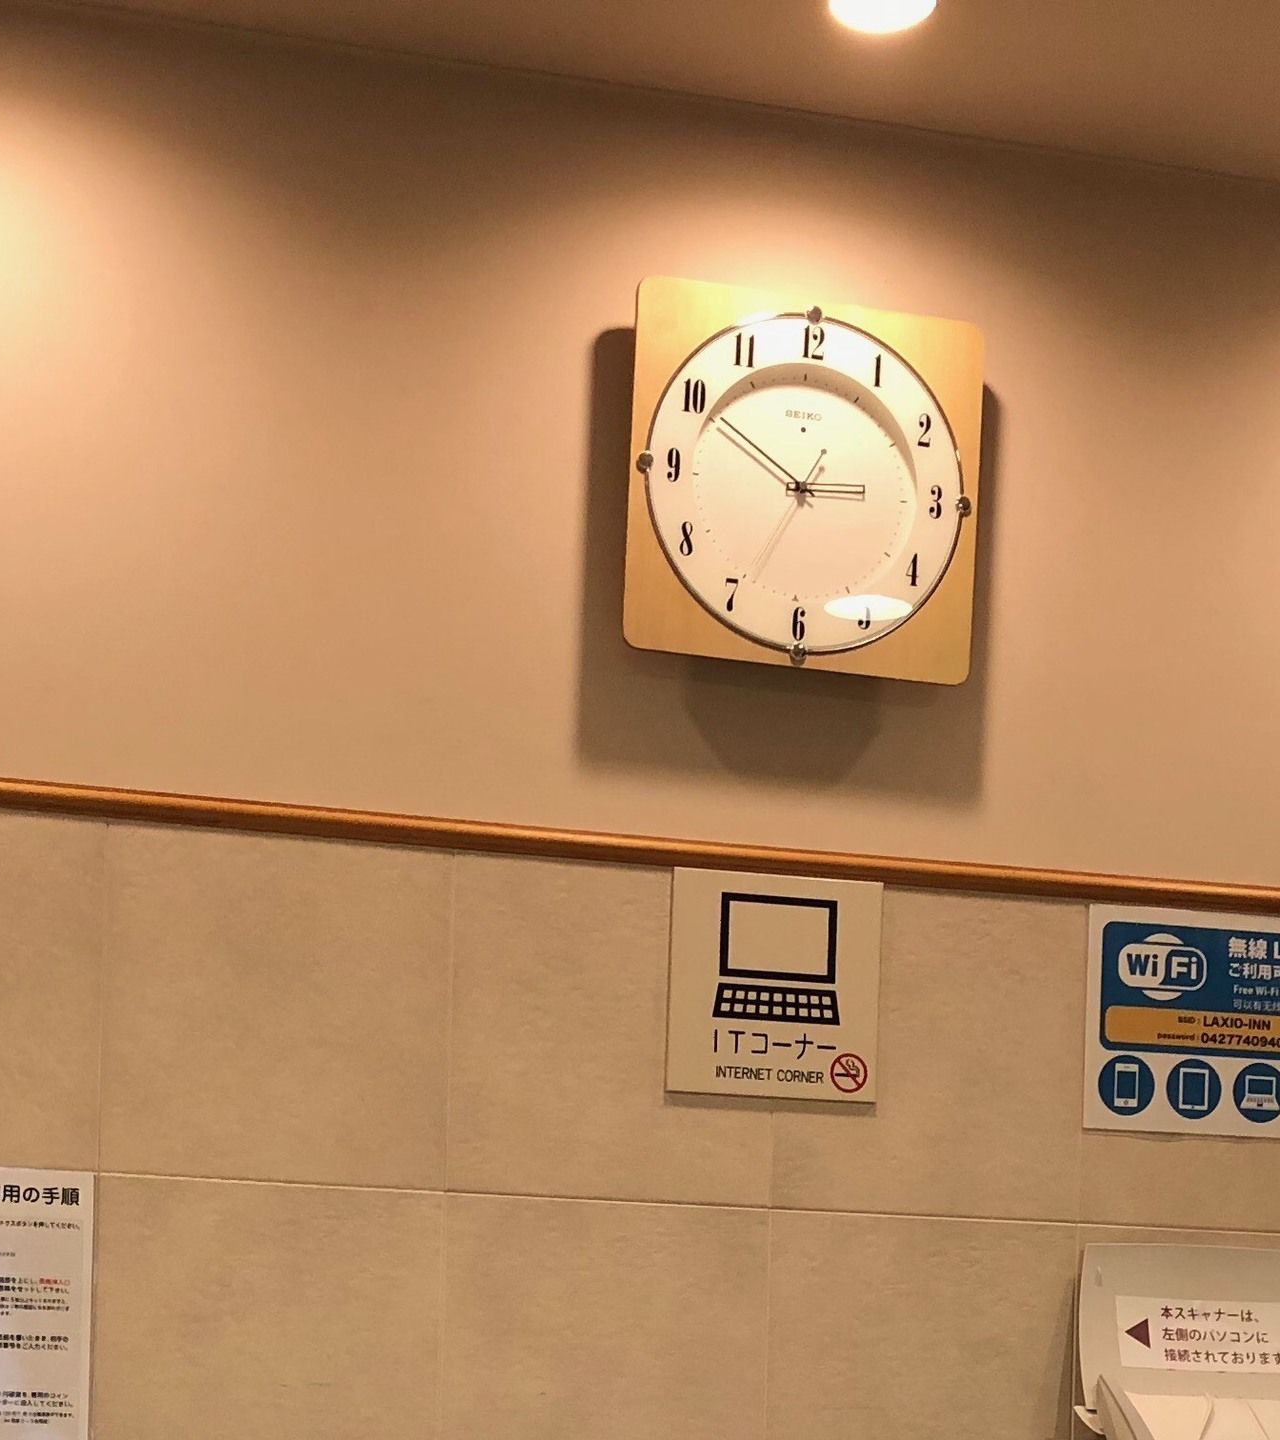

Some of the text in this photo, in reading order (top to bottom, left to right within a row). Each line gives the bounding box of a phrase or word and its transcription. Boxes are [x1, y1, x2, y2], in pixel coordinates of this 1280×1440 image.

[733, 332, 755, 368] 11
[802, 325, 825, 360] 12
[873, 354, 883, 387] 1
[682, 379, 706, 414] 10
[785, 409, 822, 421] SEIKO
[917, 413, 932, 448] 2
[666, 447, 681, 483] 9
[928, 485, 943, 520] 3
[679, 521, 694, 556] 8
[905, 553, 919, 587] 4
[725, 577, 740, 612] 7
[792, 606, 805, 642] 6
[1228, 937, 1267, 959] 無線
[1233, 984, 1254, 995] Free
[1255, 986, 1279, 996] Wi-Fi
[1203, 1016, 1271, 1030] LAXIO-INN
[715, 1065, 824, 1084] INTERNET CORNER
[1160, 1305, 1259, 1323] 本スキャナーは、
